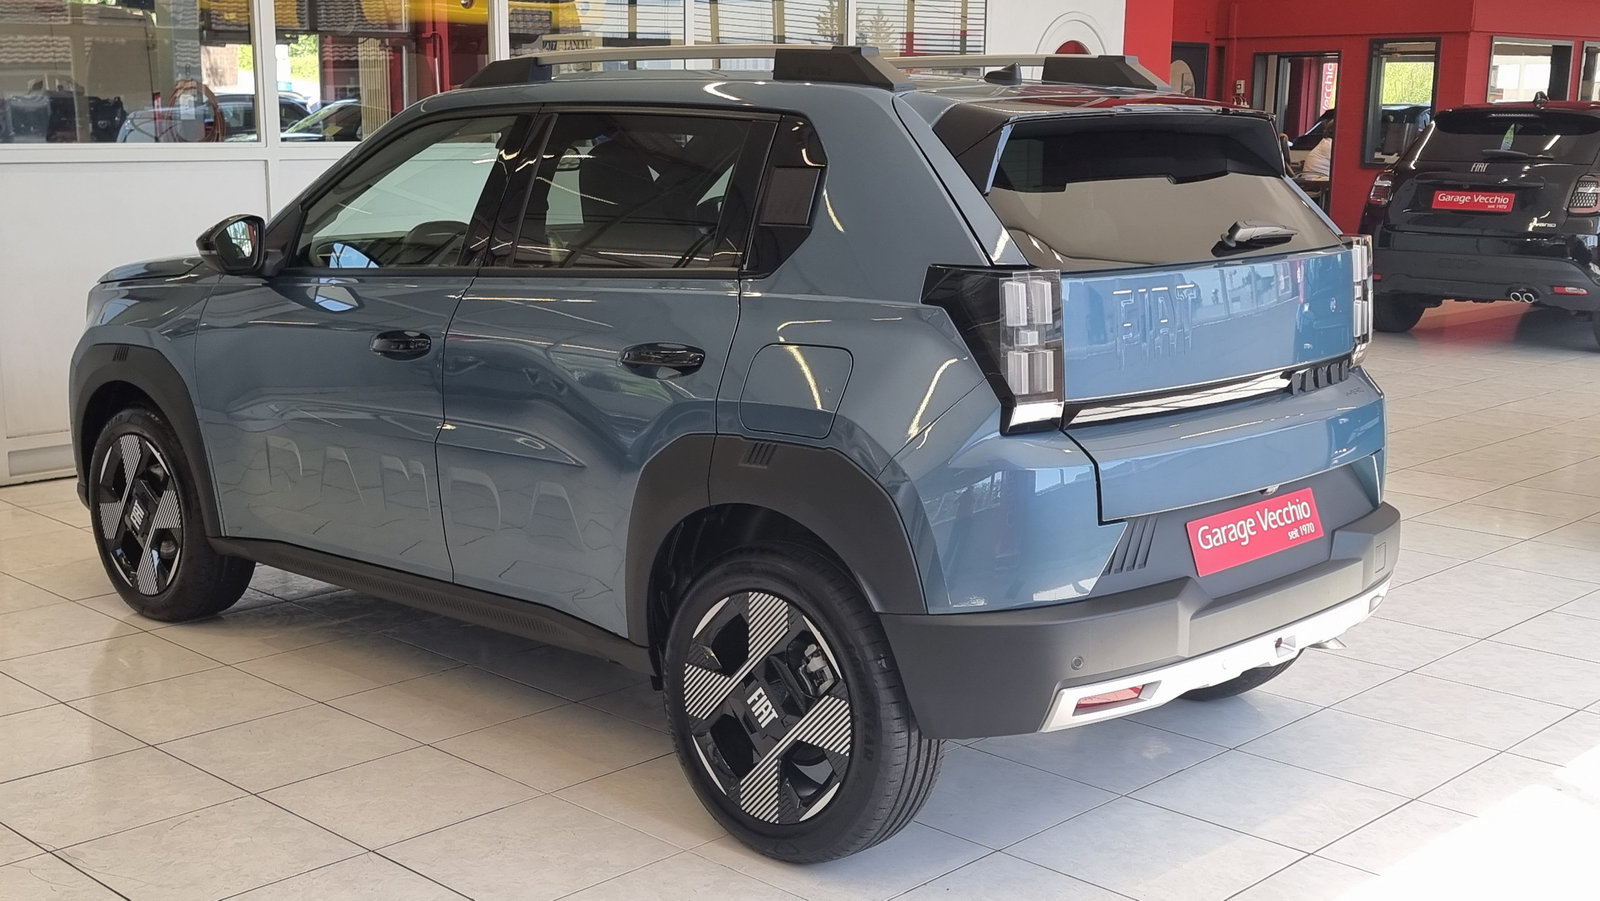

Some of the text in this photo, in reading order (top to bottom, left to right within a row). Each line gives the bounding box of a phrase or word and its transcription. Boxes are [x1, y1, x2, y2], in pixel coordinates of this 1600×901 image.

[1470, 162, 1489, 173] FIAT
[1438, 193, 1509, 204] Garage Vecchio
[1112, 283, 1196, 364] FIAT
[130, 499, 145, 530] FIAT
[1197, 498, 1311, 550] Garage Vecchio
[1287, 521, 1316, 541] seit 1970
[746, 686, 779, 729] FIAT
